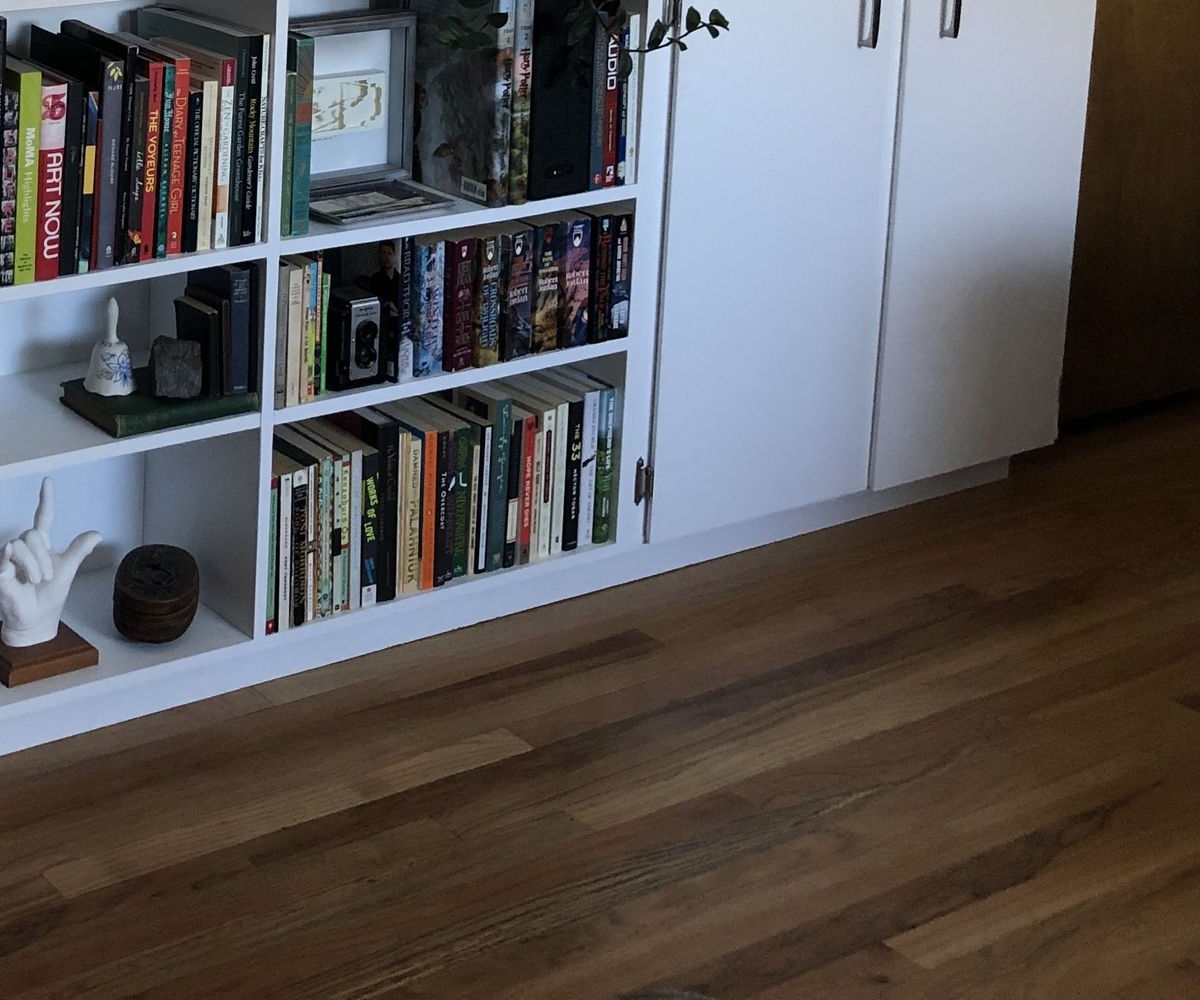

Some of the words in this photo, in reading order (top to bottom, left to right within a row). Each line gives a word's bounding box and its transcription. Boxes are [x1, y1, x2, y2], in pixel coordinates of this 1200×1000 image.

[503, 57, 513, 82] Harry
[520, 48, 532, 71] Harry
[606, 33, 619, 91] AUDIO
[501, 82, 512, 109] Potter
[518, 71, 530, 98] Potter
[223, 99, 232, 120] ZEN
[238, 92, 246, 105] The
[248, 98, 257, 118] Rocky
[149, 109, 158, 132] THE
[174, 97, 187, 129] DIARY
[237, 107, 245, 129] Forest
[24, 127, 37, 168] MoMA
[236, 131, 244, 156] Garden
[247, 119, 256, 153] Mountain
[46, 151, 63, 196] ART
[145, 136, 157, 193] VOYEURS
[171, 137, 185, 185] TEENAGE
[245, 155, 254, 190] Gardener's
[233, 158, 243, 201] Greenhouse
[22, 171, 35, 223] Highlights
[169, 188, 182, 215] GIRL
[244, 190, 253, 210] Guide
[43, 200, 61, 259] NOW
[402, 251, 411, 283] BRAD
[482, 285, 490, 297] OF
[481, 302, 489, 347] TWILIGHT
[488, 282, 497, 347] CROSSROADS
[573, 423, 581, 440] THE
[571, 441, 582, 462] 33
[411, 450, 420, 489] DAMNED
[440, 472, 448, 487] THE
[524, 455, 532, 479] HOPE
[365, 476, 378, 506] WORKS
[523, 480, 531, 508] NEVER
[366, 508, 377, 519] OF
[363, 521, 376, 543] LOVE
[407, 499, 420, 585] PALAHNIUK
